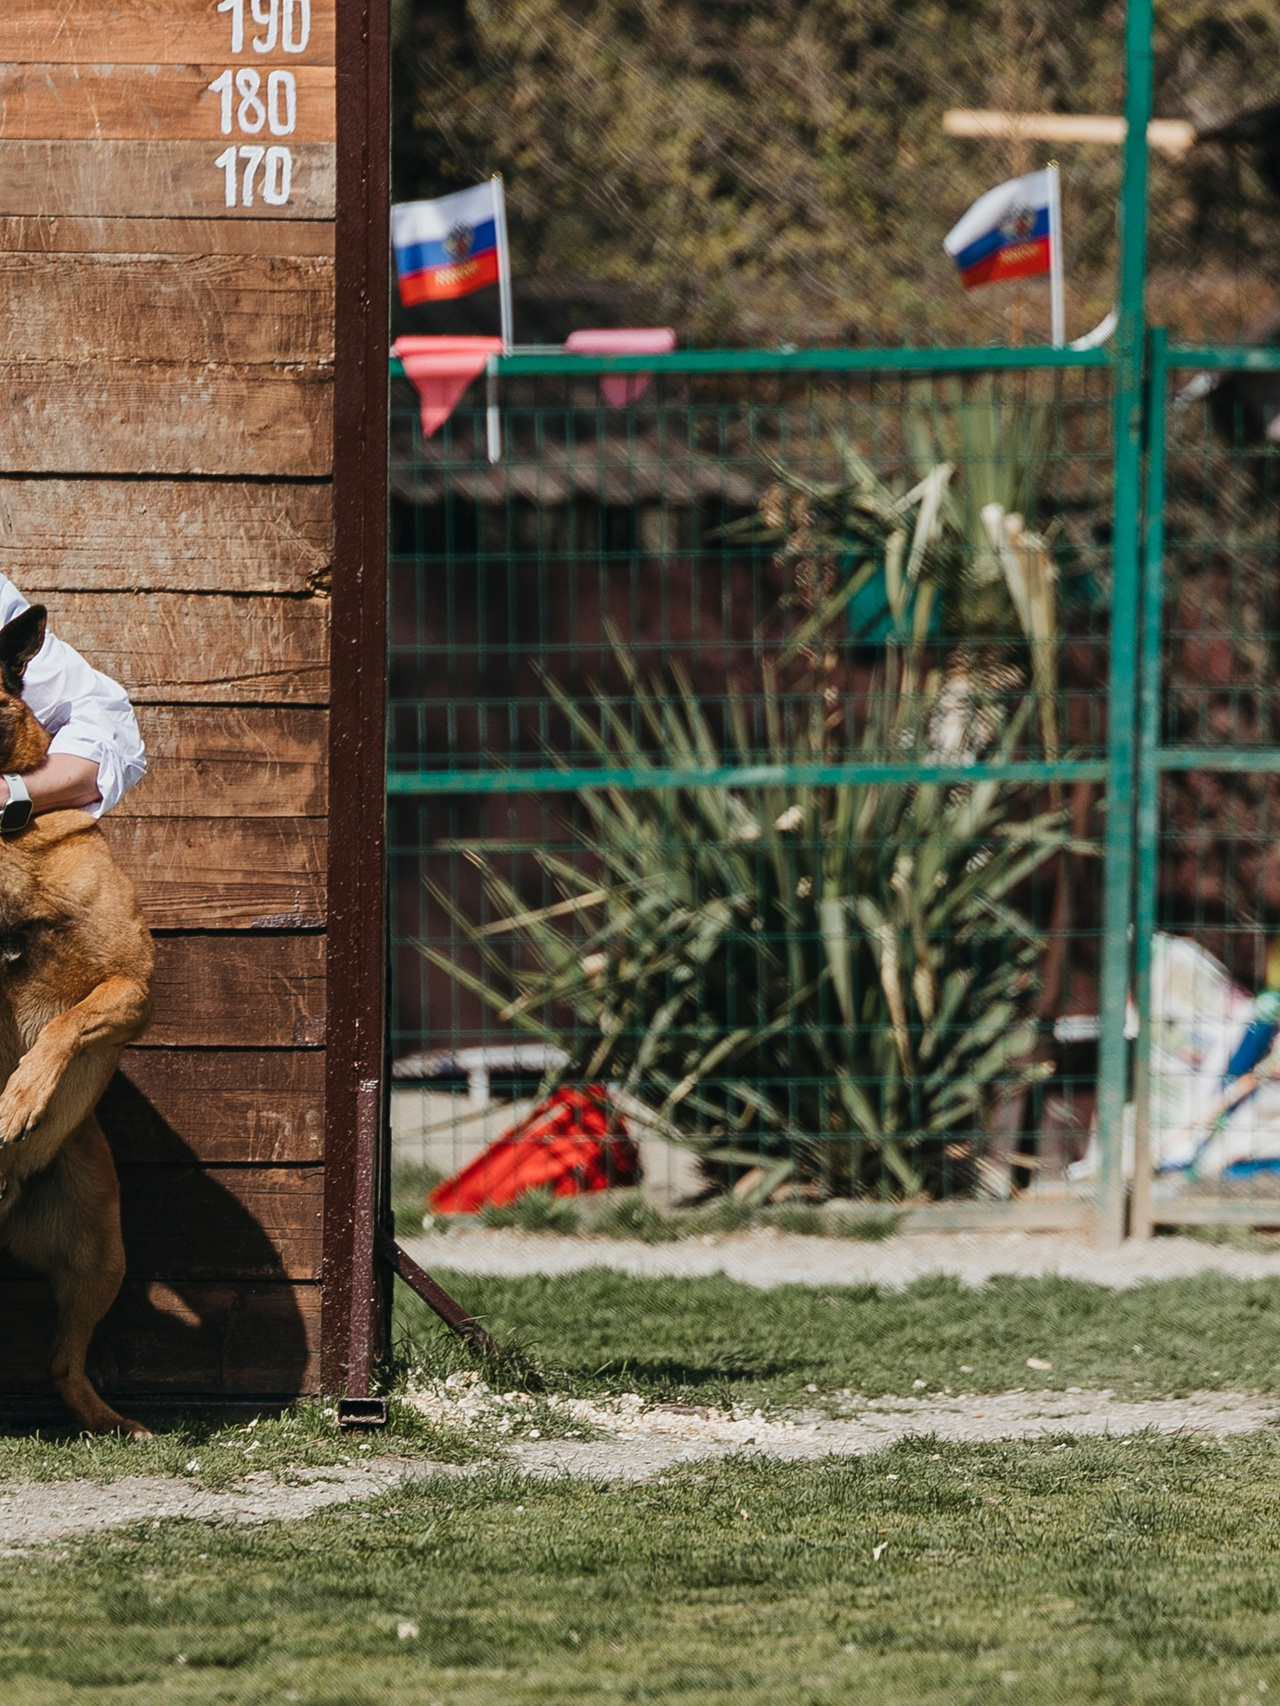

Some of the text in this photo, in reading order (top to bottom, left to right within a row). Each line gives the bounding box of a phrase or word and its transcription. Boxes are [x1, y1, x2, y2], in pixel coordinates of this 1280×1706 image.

[217, 0, 311, 54] 190
[208, 68, 297, 136] 180
[214, 145, 293, 208] 170
